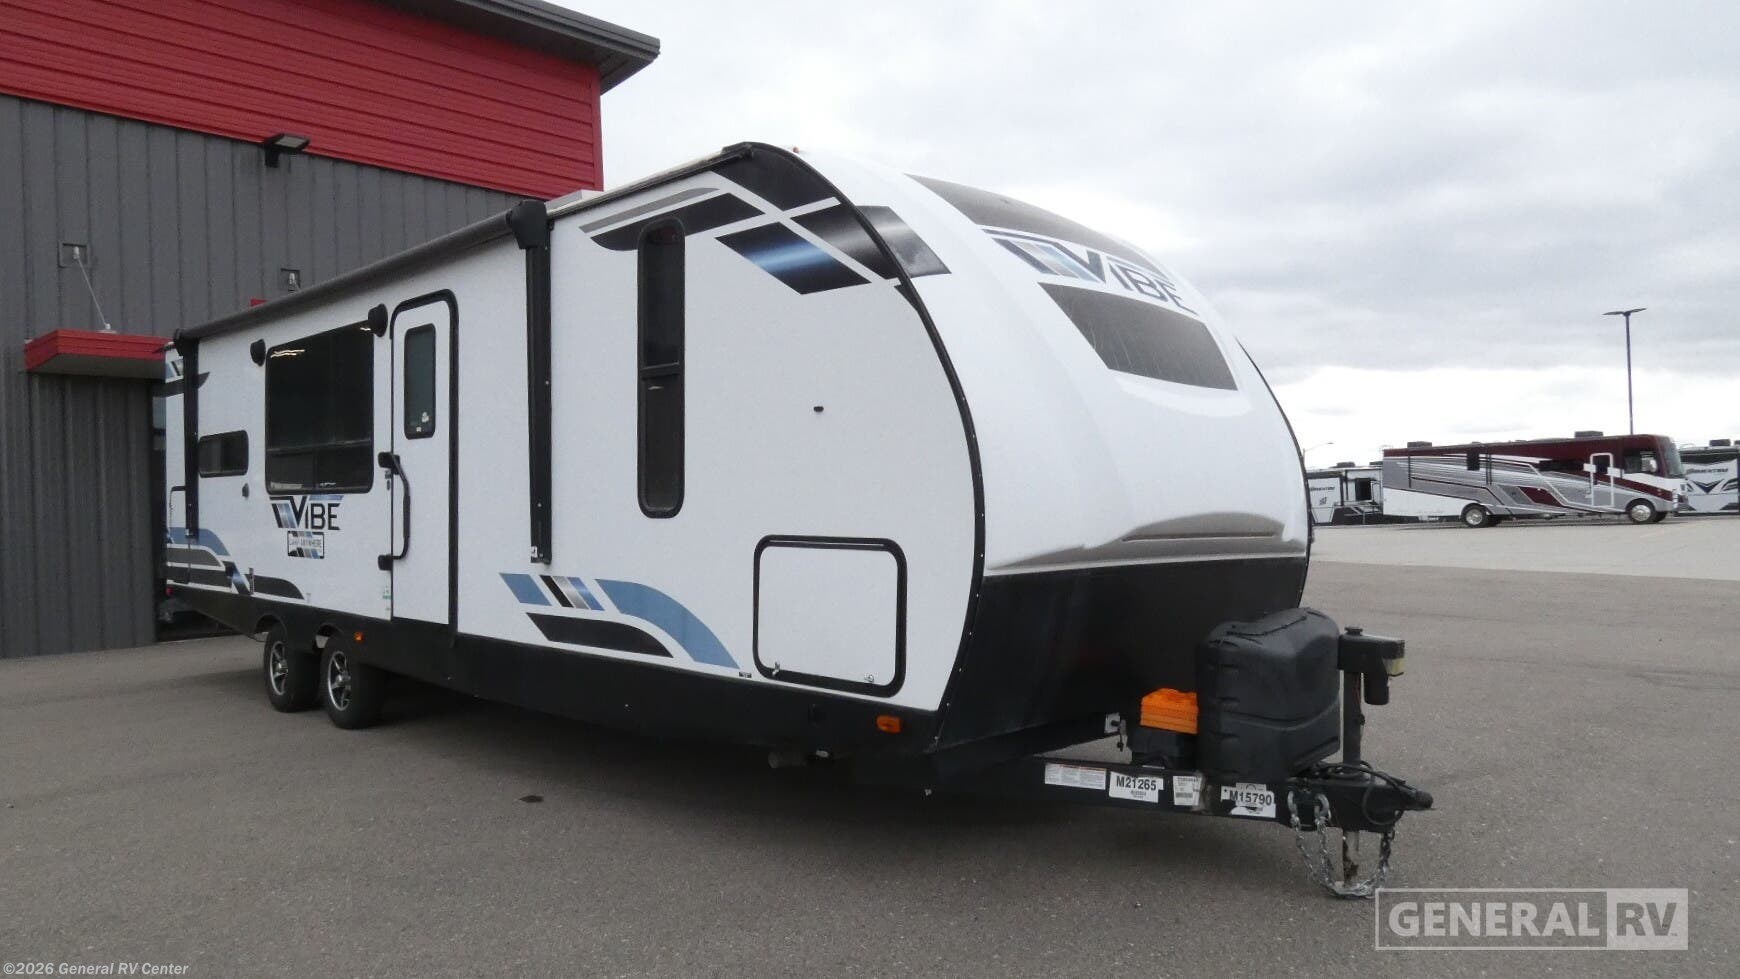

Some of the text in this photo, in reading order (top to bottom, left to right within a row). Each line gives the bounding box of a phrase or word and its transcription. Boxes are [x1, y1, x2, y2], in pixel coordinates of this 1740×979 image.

[980, 228, 1198, 316] VIBE
[269, 495, 341, 530] VIBE
[1116, 775, 1157, 791] M21265
[1230, 790, 1272, 806] M15790
